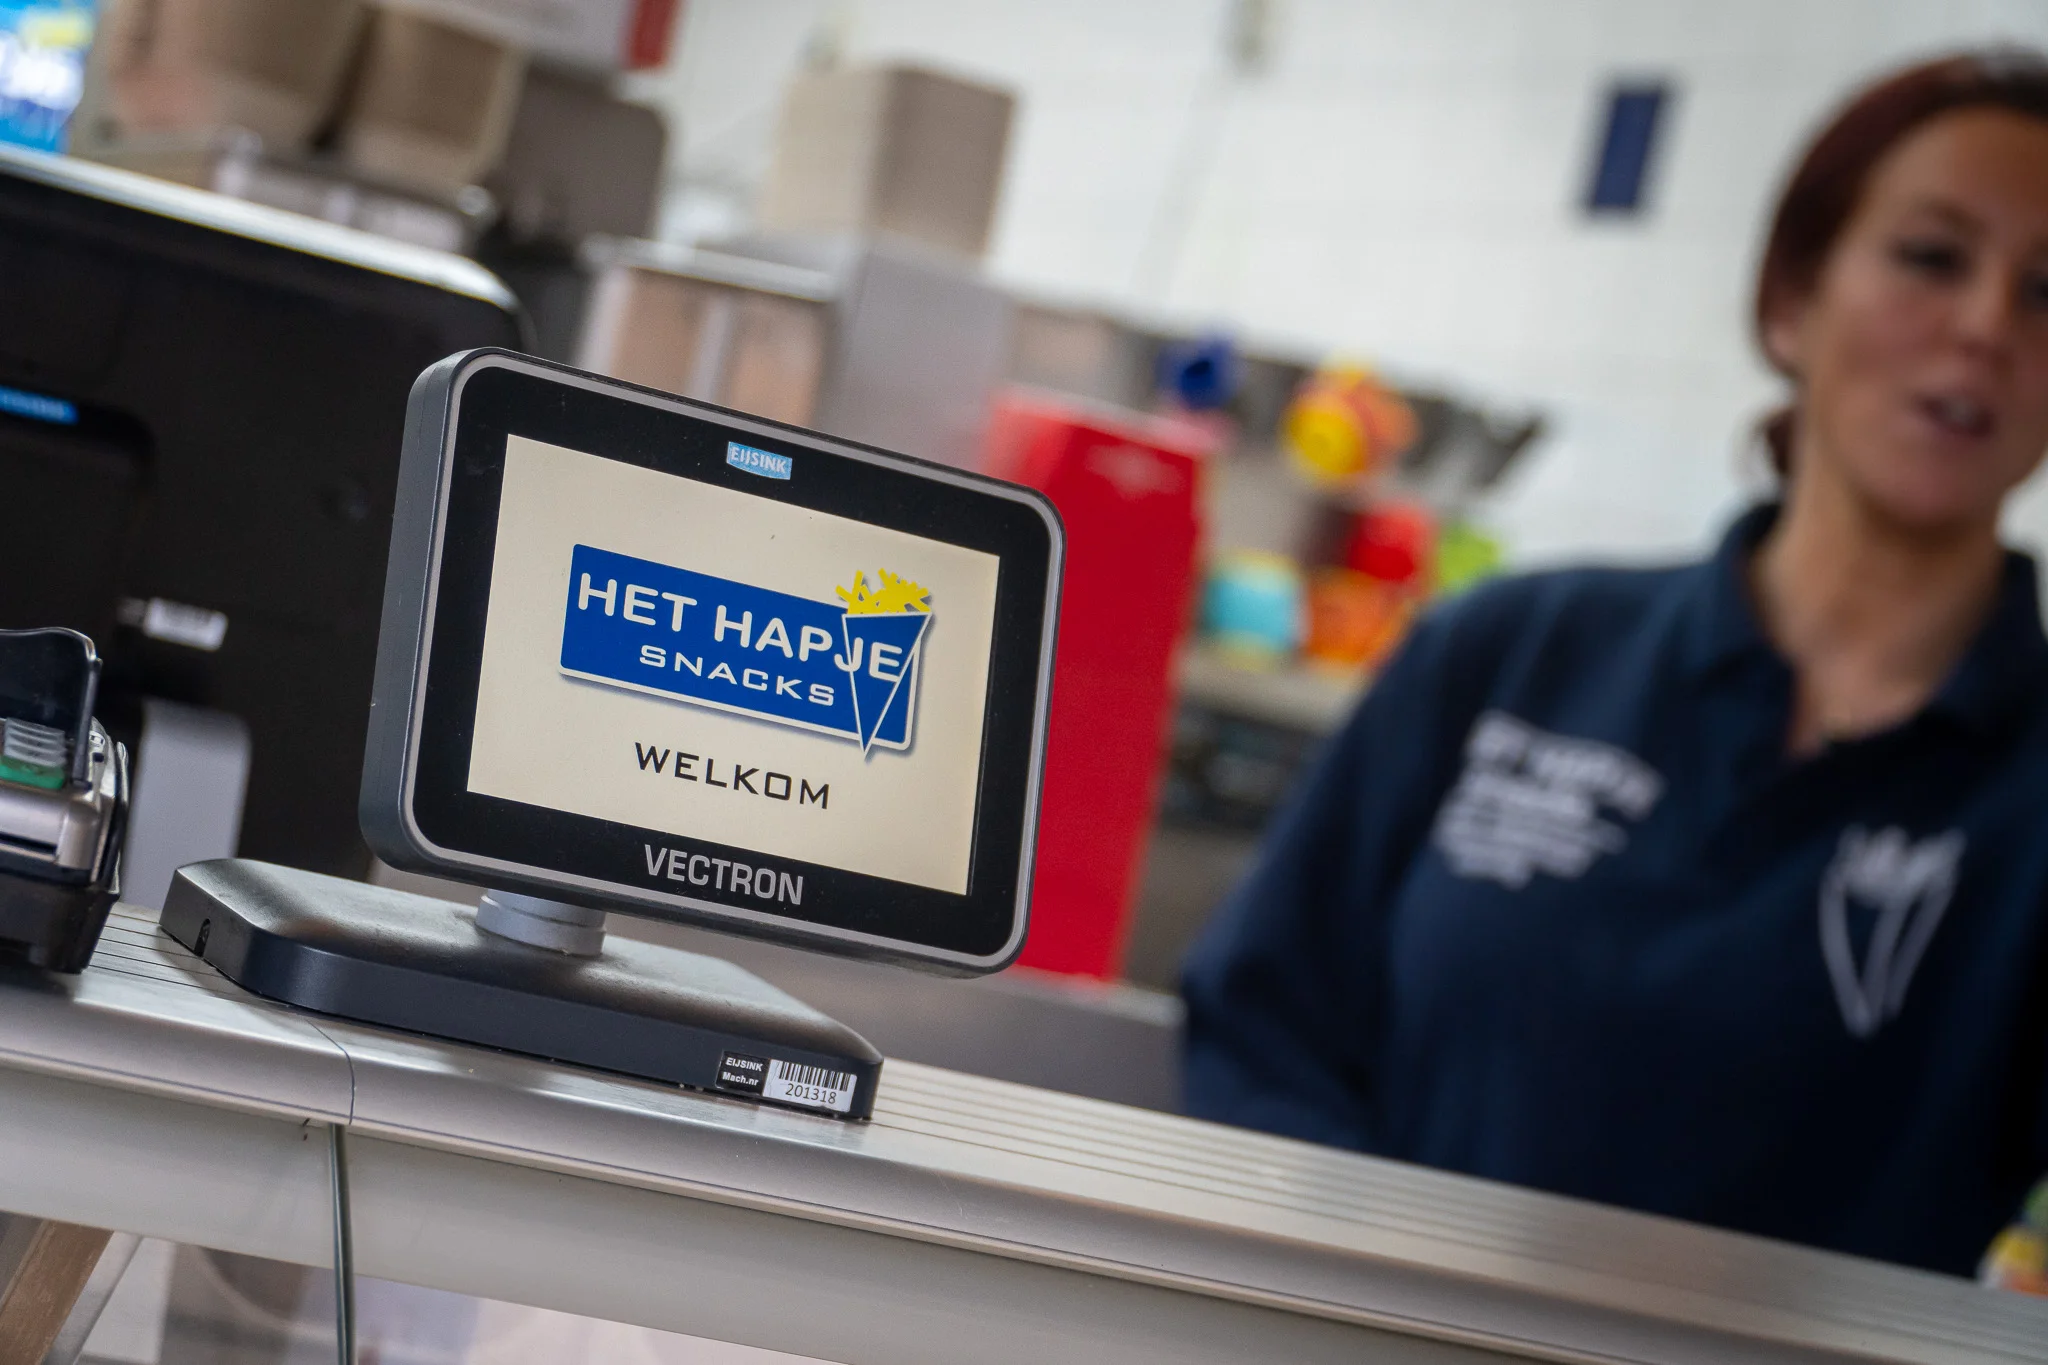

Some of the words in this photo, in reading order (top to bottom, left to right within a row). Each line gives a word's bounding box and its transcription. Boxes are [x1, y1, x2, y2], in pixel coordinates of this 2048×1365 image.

[731, 446, 786, 474] EIJSINK
[577, 572, 697, 633] HET
[714, 604, 903, 682] HAPJE
[640, 645, 836, 707] SNACKS
[635, 742, 829, 810] WELKOM
[644, 844, 804, 907] VECTRON
[722, 1072, 759, 1086] Mach.nr
[725, 1057, 763, 1072] EIJSINK
[785, 1083, 837, 1104] 201318
